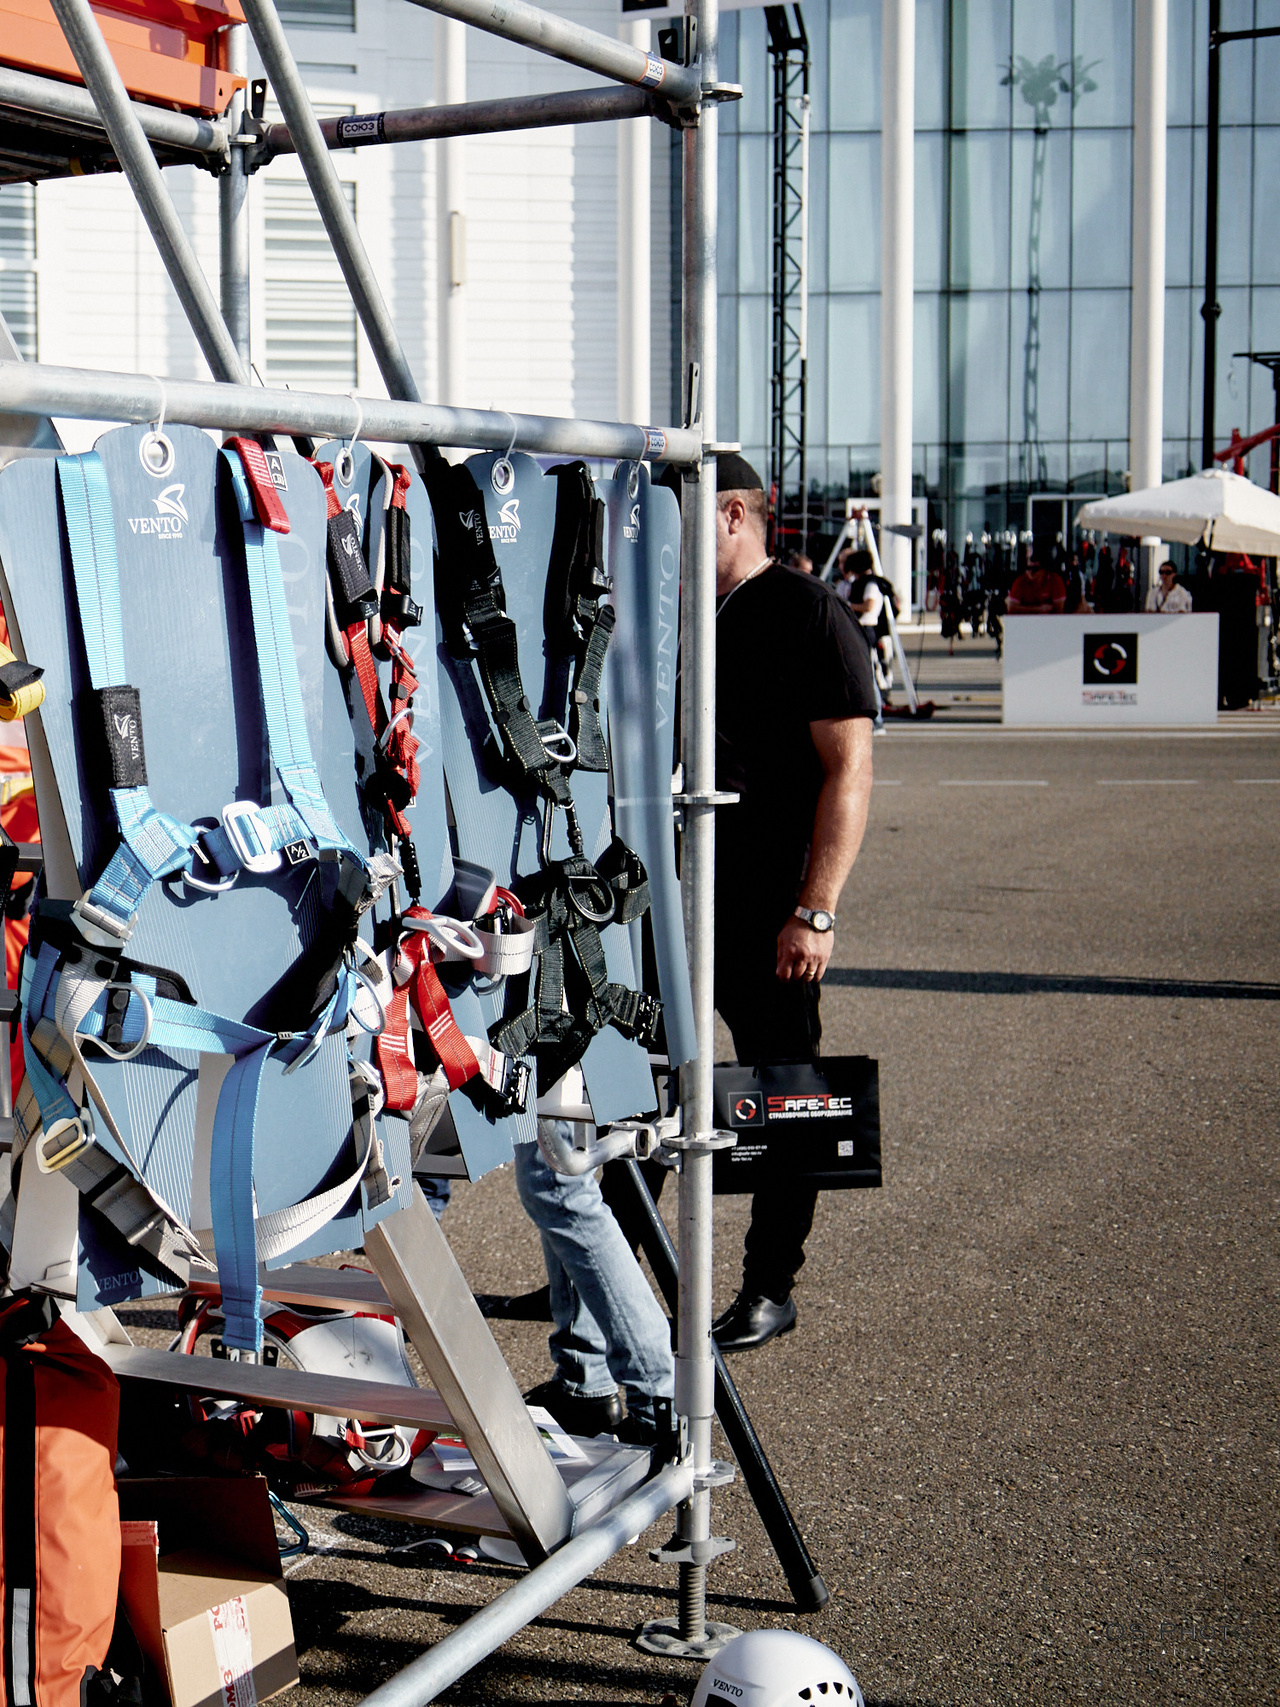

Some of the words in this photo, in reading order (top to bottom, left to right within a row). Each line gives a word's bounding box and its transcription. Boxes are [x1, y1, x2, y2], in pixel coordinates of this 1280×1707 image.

[345, 122, 375, 132] СОЮЗ
[128, 517, 182, 534] VENTO
[474, 513, 484, 546] VENTO
[488, 525, 517, 539] ENTO
[349, 537, 363, 572] VENTO
[655, 543, 675, 735] VENTO
[128, 720, 140, 760] VENTO
[290, 845, 308, 858] A/2
[767, 1094, 852, 1112] SAFE-TEC
[713, 1678, 743, 1698] VENTO
